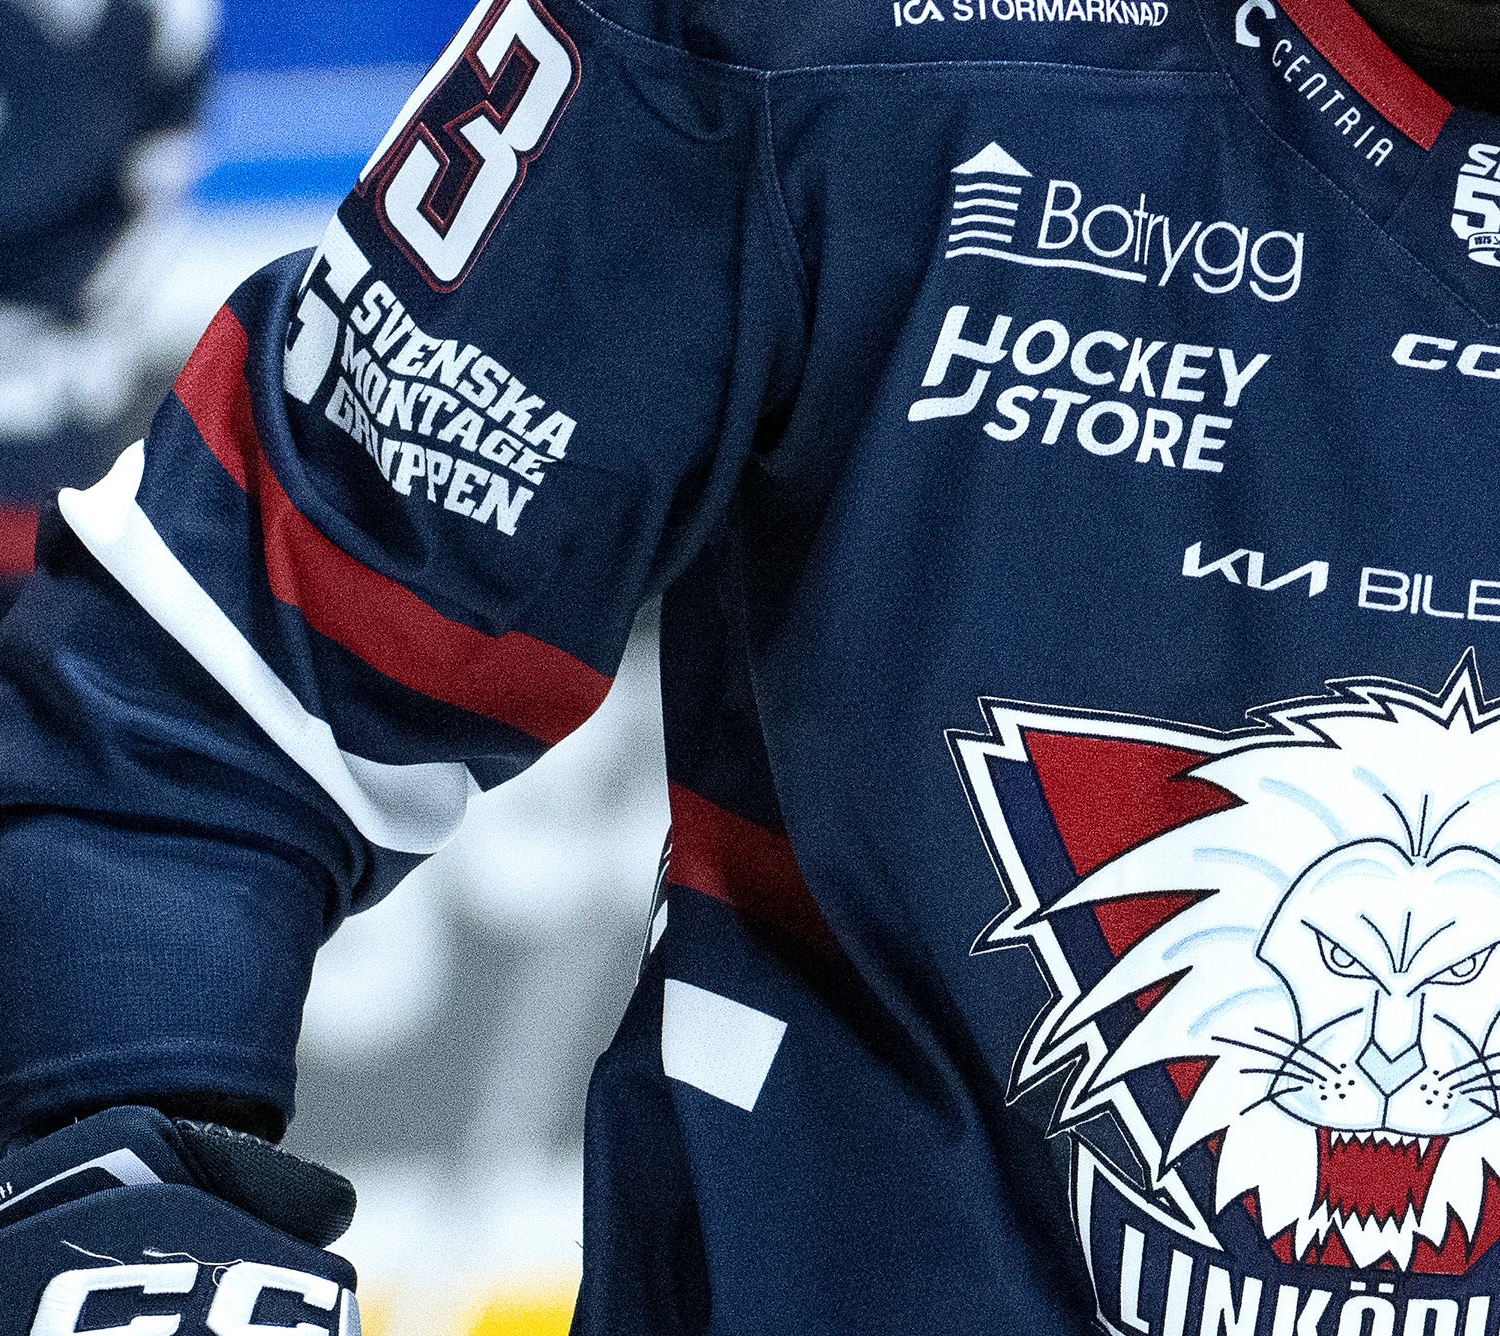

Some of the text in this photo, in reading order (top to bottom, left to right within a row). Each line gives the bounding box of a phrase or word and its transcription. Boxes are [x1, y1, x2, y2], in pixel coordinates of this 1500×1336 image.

[1271, 38, 1395, 167] CENTRIA
[1036, 179, 1305, 303] Botrygg
[340, 323, 558, 486] MONTAGE
[349, 279, 578, 460] SVENSKA
[920, 304, 1273, 410] HOCKEY
[324, 375, 535, 538] GRUPPEN
[982, 384, 1235, 474] STORE
